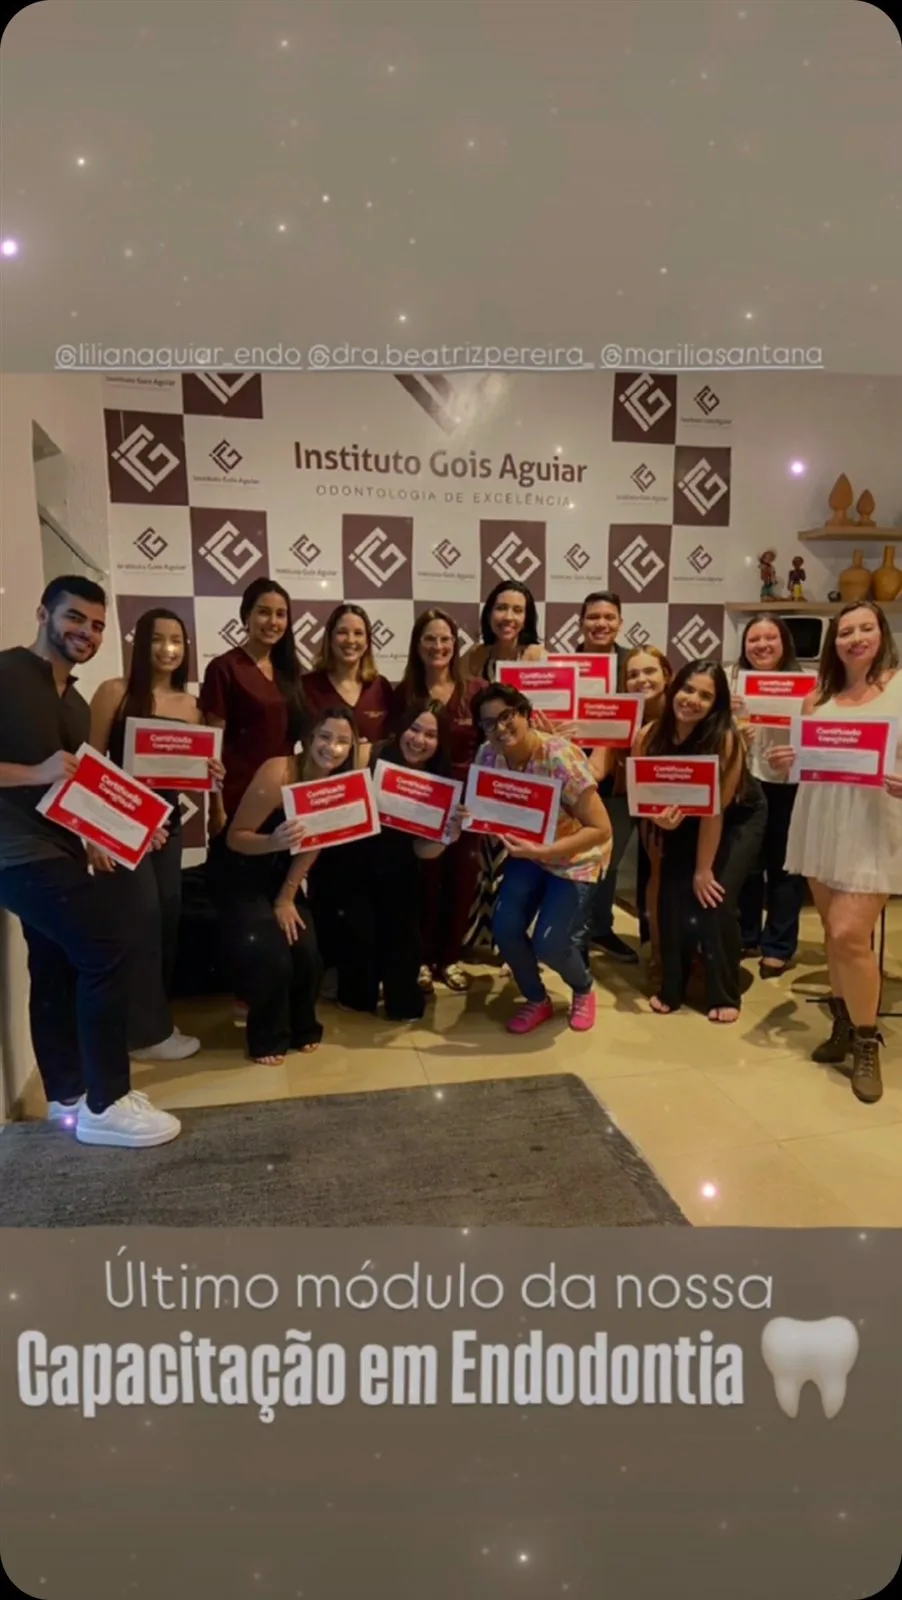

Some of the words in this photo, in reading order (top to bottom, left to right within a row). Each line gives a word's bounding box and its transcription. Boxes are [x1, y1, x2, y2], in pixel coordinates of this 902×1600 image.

[294, 441, 421, 475] Instituto
[429, 450, 492, 479] Gois
[499, 453, 588, 488] Aguiar
[316, 484, 437, 502] ODONTOLOGIA
[444, 491, 464, 504] DE
[473, 489, 571, 507] EXCELÊNCIA
